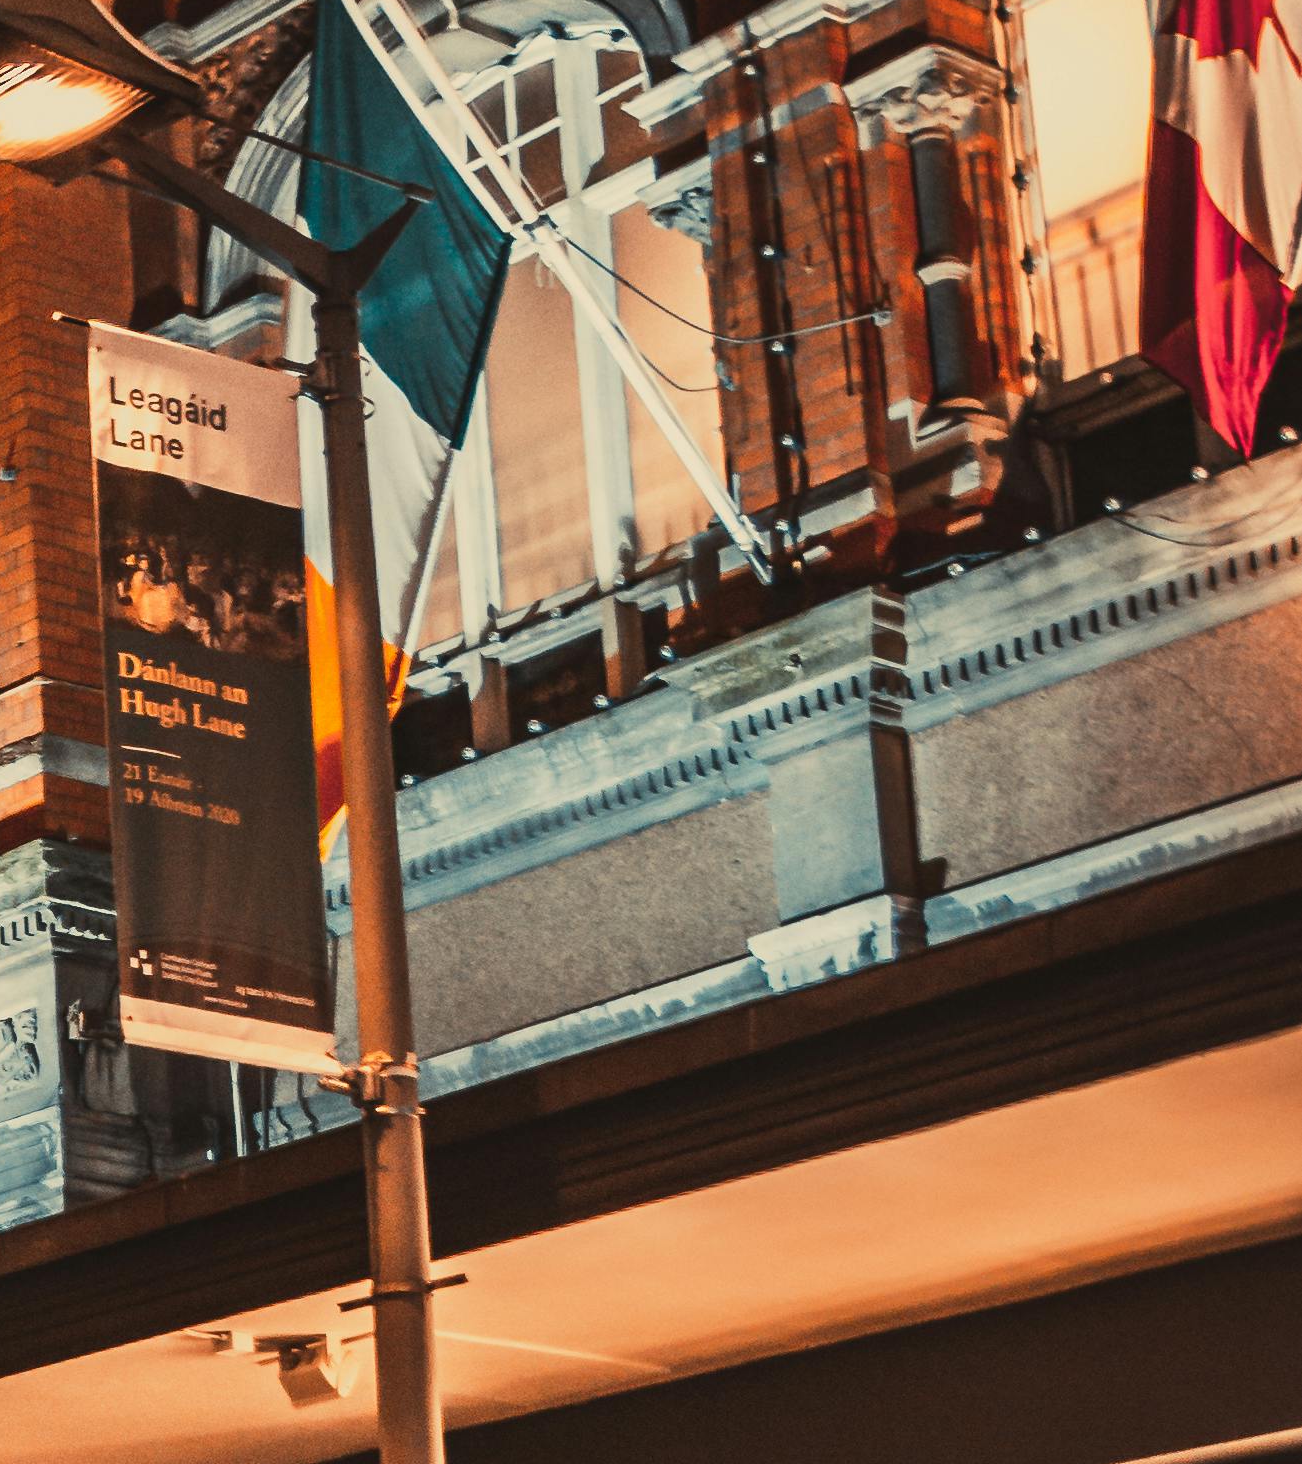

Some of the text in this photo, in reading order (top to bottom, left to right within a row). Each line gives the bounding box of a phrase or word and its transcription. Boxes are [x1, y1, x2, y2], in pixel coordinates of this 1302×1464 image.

[109, 376, 227, 432] Leagáid
[110, 418, 185, 460] Lane
[221, 685, 248, 705] an
[120, 687, 246, 739] Hugh Lane
[123, 762, 141, 780] 21
[125, 787, 144, 804] 19
